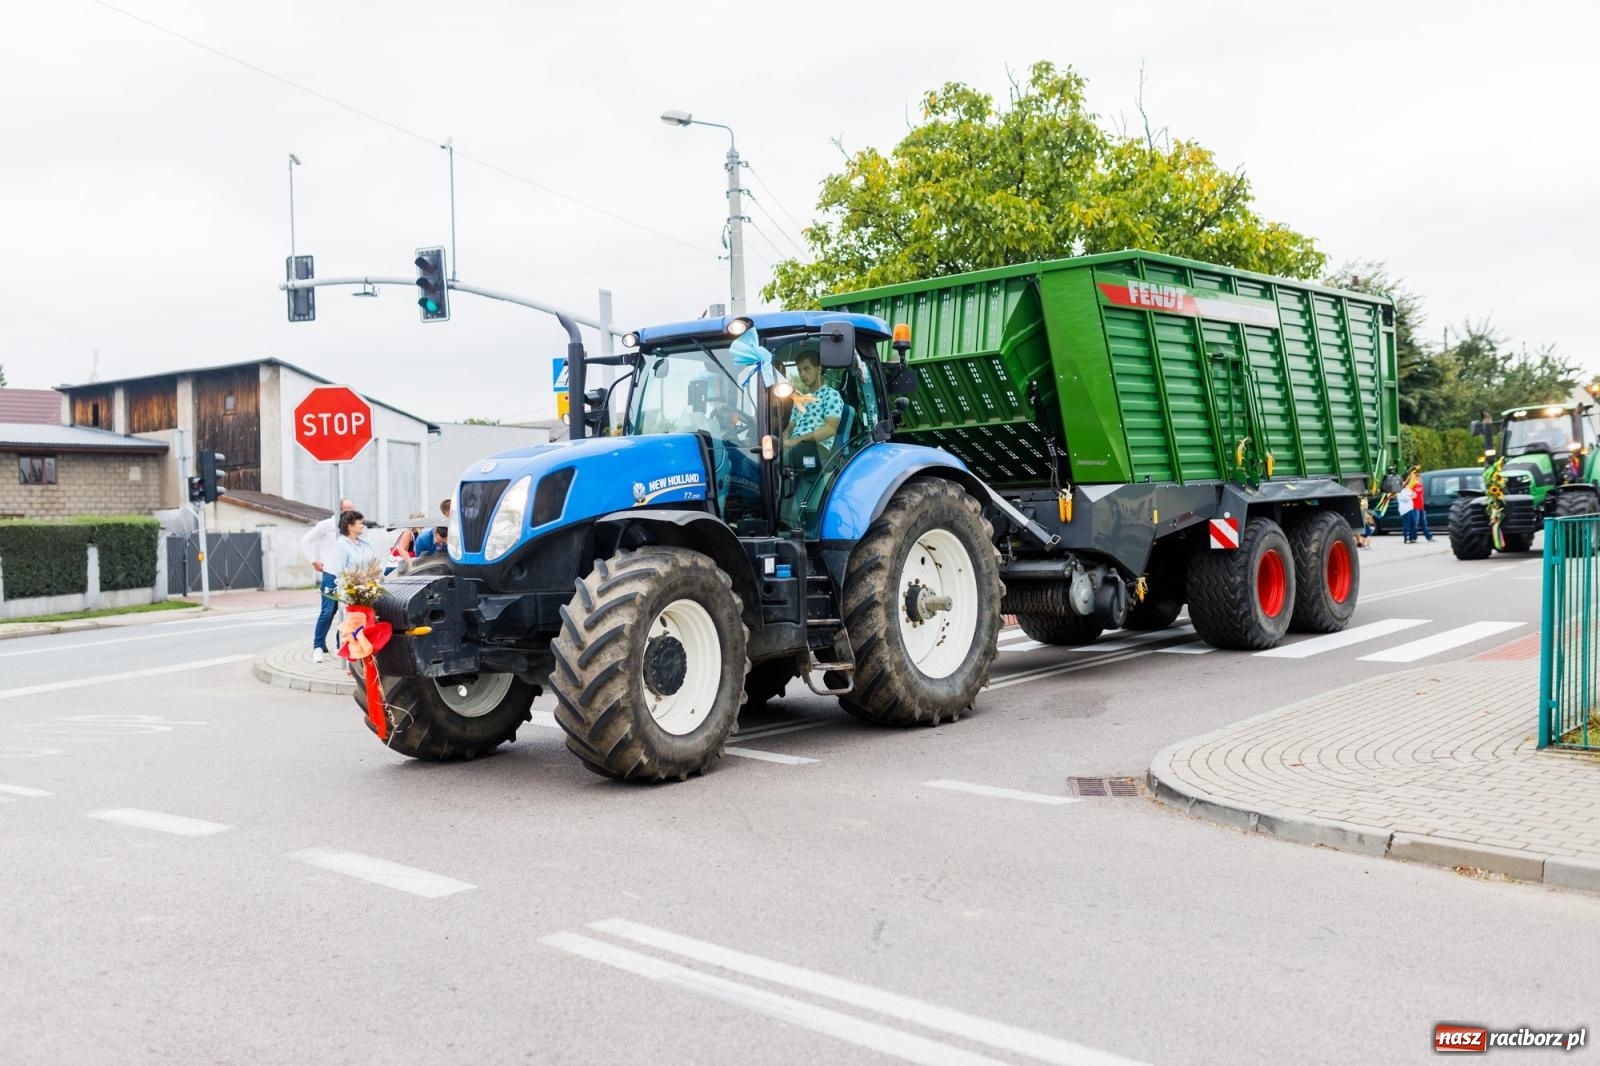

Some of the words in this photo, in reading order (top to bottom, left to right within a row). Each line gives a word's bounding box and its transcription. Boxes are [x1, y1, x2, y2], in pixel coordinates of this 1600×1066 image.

[1127, 280, 1187, 310] FENDT
[302, 412, 365, 437] STOP
[648, 477, 667, 492] NEW
[667, 473, 700, 487] HOLLAND
